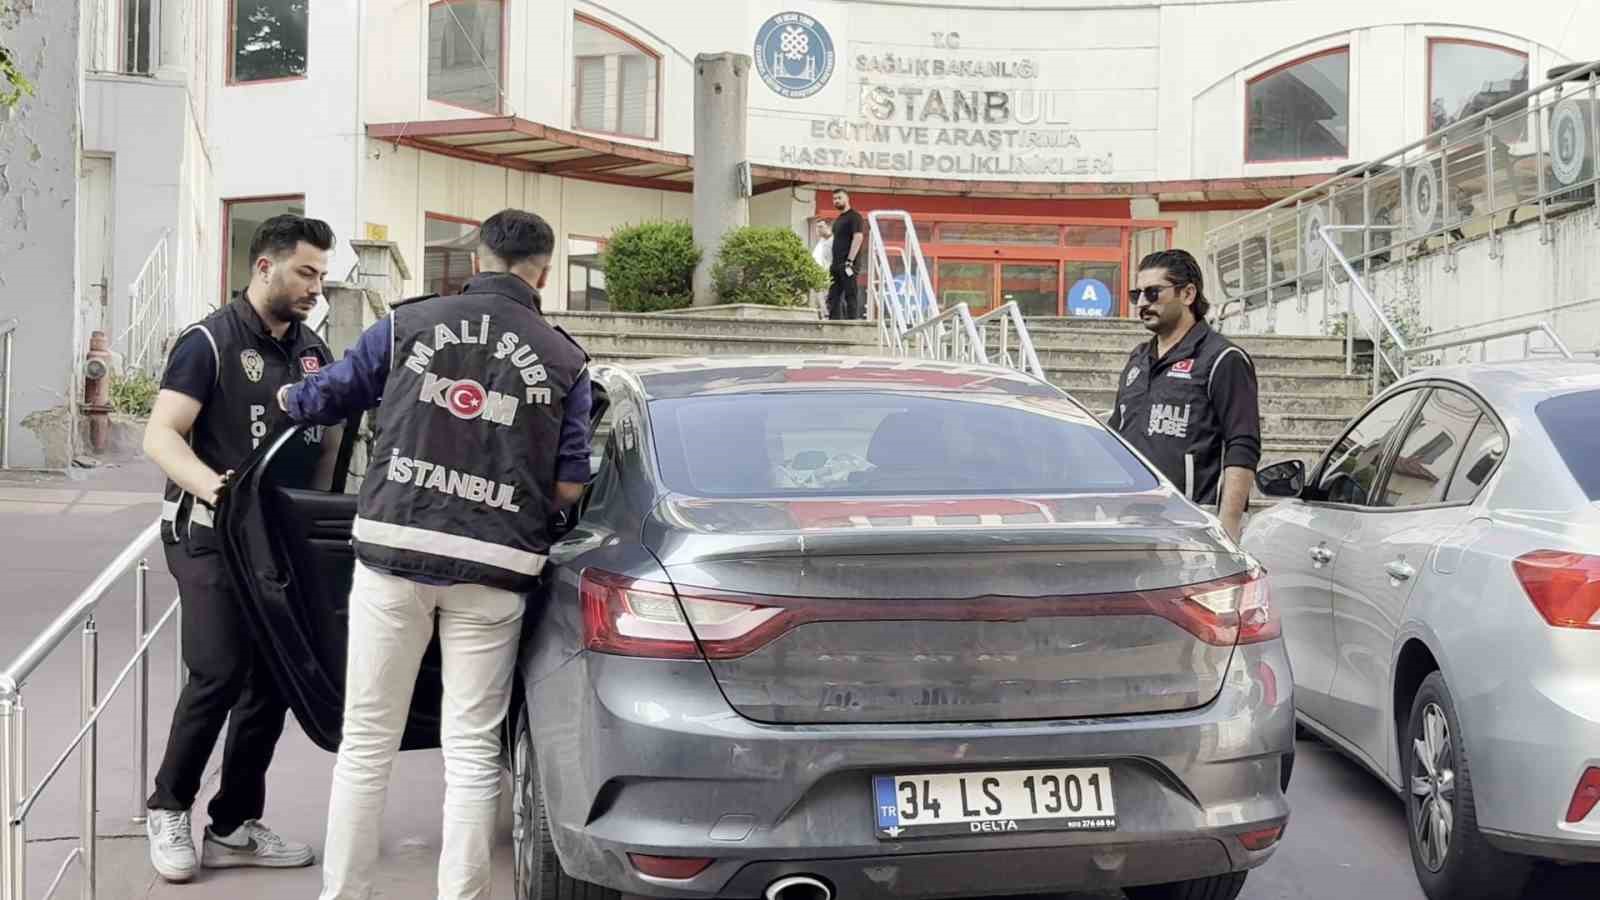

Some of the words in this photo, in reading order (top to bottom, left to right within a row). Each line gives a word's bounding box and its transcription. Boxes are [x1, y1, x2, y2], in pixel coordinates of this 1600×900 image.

[856, 53, 930, 77] SAĞLIK
[859, 76, 1071, 125] İSTANBUL
[899, 126, 929, 145] VE
[780, 145, 912, 171] HASTANESİ
[1081, 285, 1097, 301] A
[404, 314, 491, 375] MALİ
[493, 331, 551, 405] ŞUBE
[387, 448, 520, 513] İSTANBUL
[898, 780, 941, 820] 34
[959, 777, 1001, 817] LS
[1023, 773, 1103, 814] 1301
[880, 805, 897, 817] TR
[970, 820, 1018, 832] DELTA
